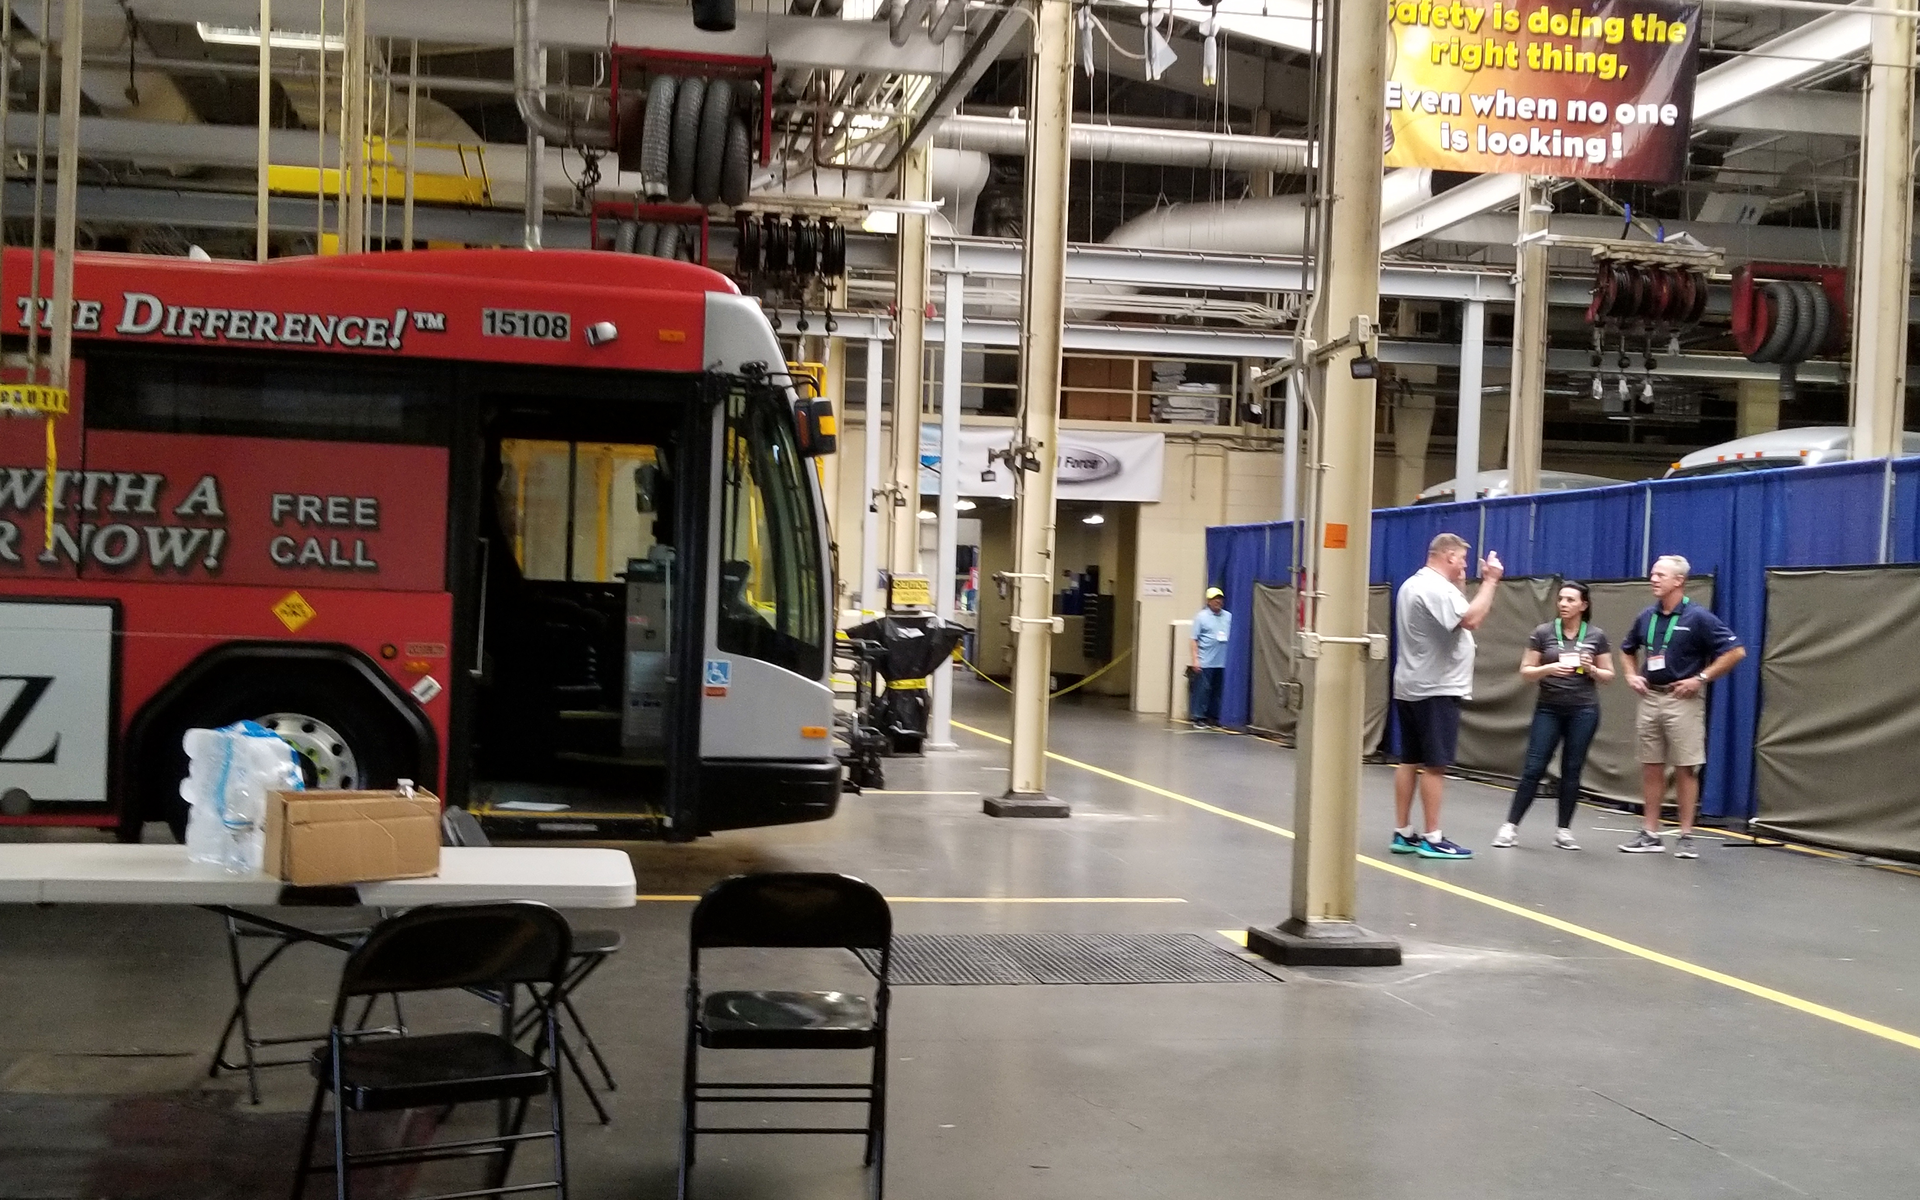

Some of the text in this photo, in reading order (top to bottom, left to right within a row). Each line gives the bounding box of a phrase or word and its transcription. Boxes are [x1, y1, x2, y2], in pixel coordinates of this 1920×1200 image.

[1493, 2, 1520, 32] is
[1527, 5, 1625, 44] doing
[1631, 13, 1687, 43] the
[1431, 36, 1629, 80] right thing,
[1386, 81, 1679, 126] Even when no one
[1440, 121, 1624, 164] is looking!
[484, 310, 568, 339] 15108
[174, 474, 225, 516] A
[271, 493, 378, 526] FREE
[38, 521, 226, 570] NOW!
[269, 535, 378, 569] CALL
[0, 675, 62, 764] Z
